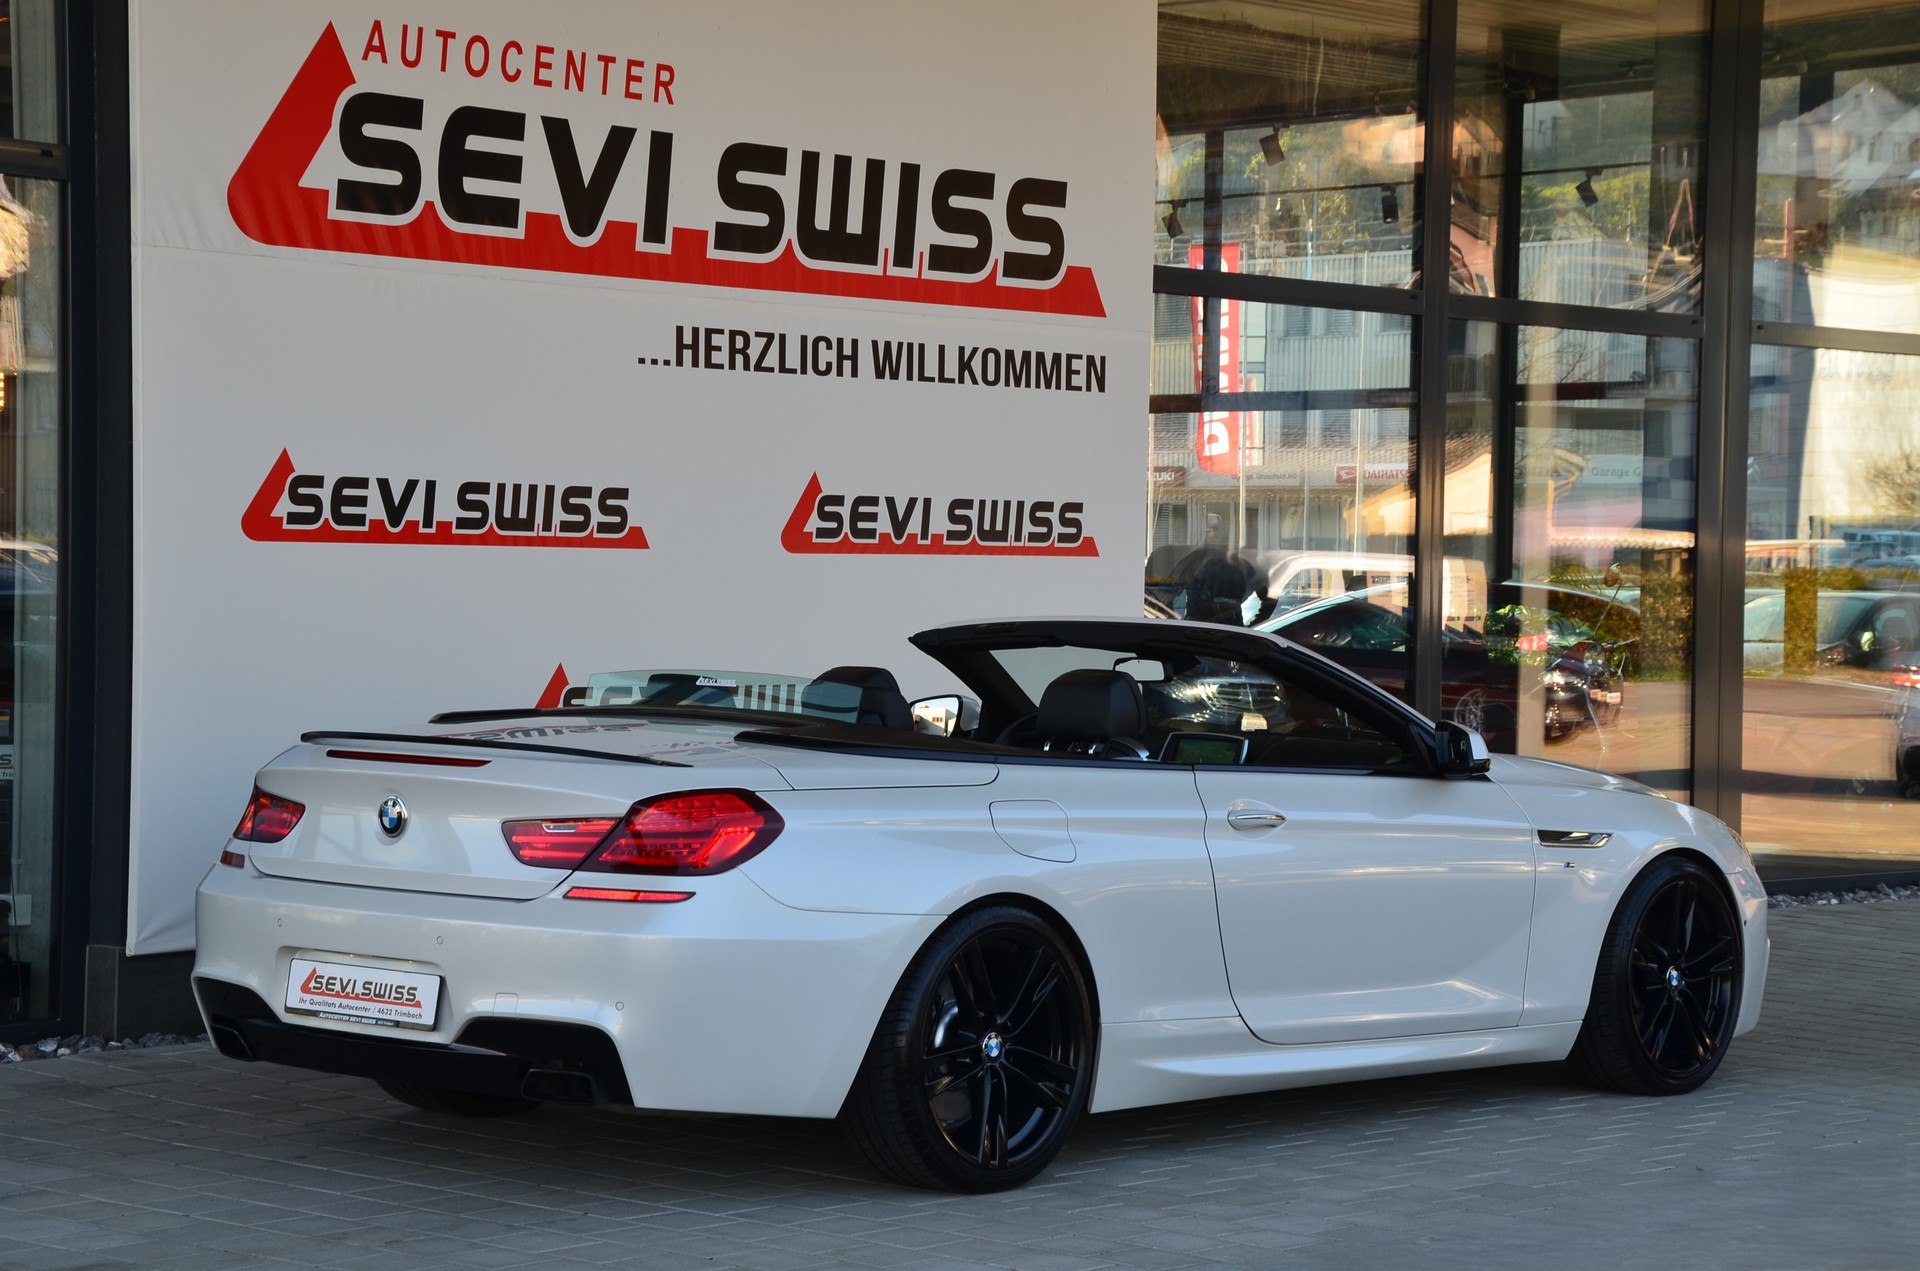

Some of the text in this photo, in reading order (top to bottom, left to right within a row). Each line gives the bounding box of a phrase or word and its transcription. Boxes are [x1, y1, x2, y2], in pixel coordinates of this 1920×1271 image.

[362, 20, 676, 105] AUTOCENTER
[336, 92, 1068, 281] SEVI SWISS
[637, 325, 1107, 393] ...HERZLICH WILLKOMMEN
[286, 474, 630, 534] SEVI SWISS
[1147, 472, 1175, 482] ZUKI
[815, 495, 1084, 544] SEVI SWISS
[298, 997, 307, 1005] Ihr
[337, 1002, 371, 1013] Autocenter
[377, 1008, 393, 1016] 4632
[394, 1009, 423, 1020] Trimbach
[313, 974, 418, 1003] SEVI SWISS
